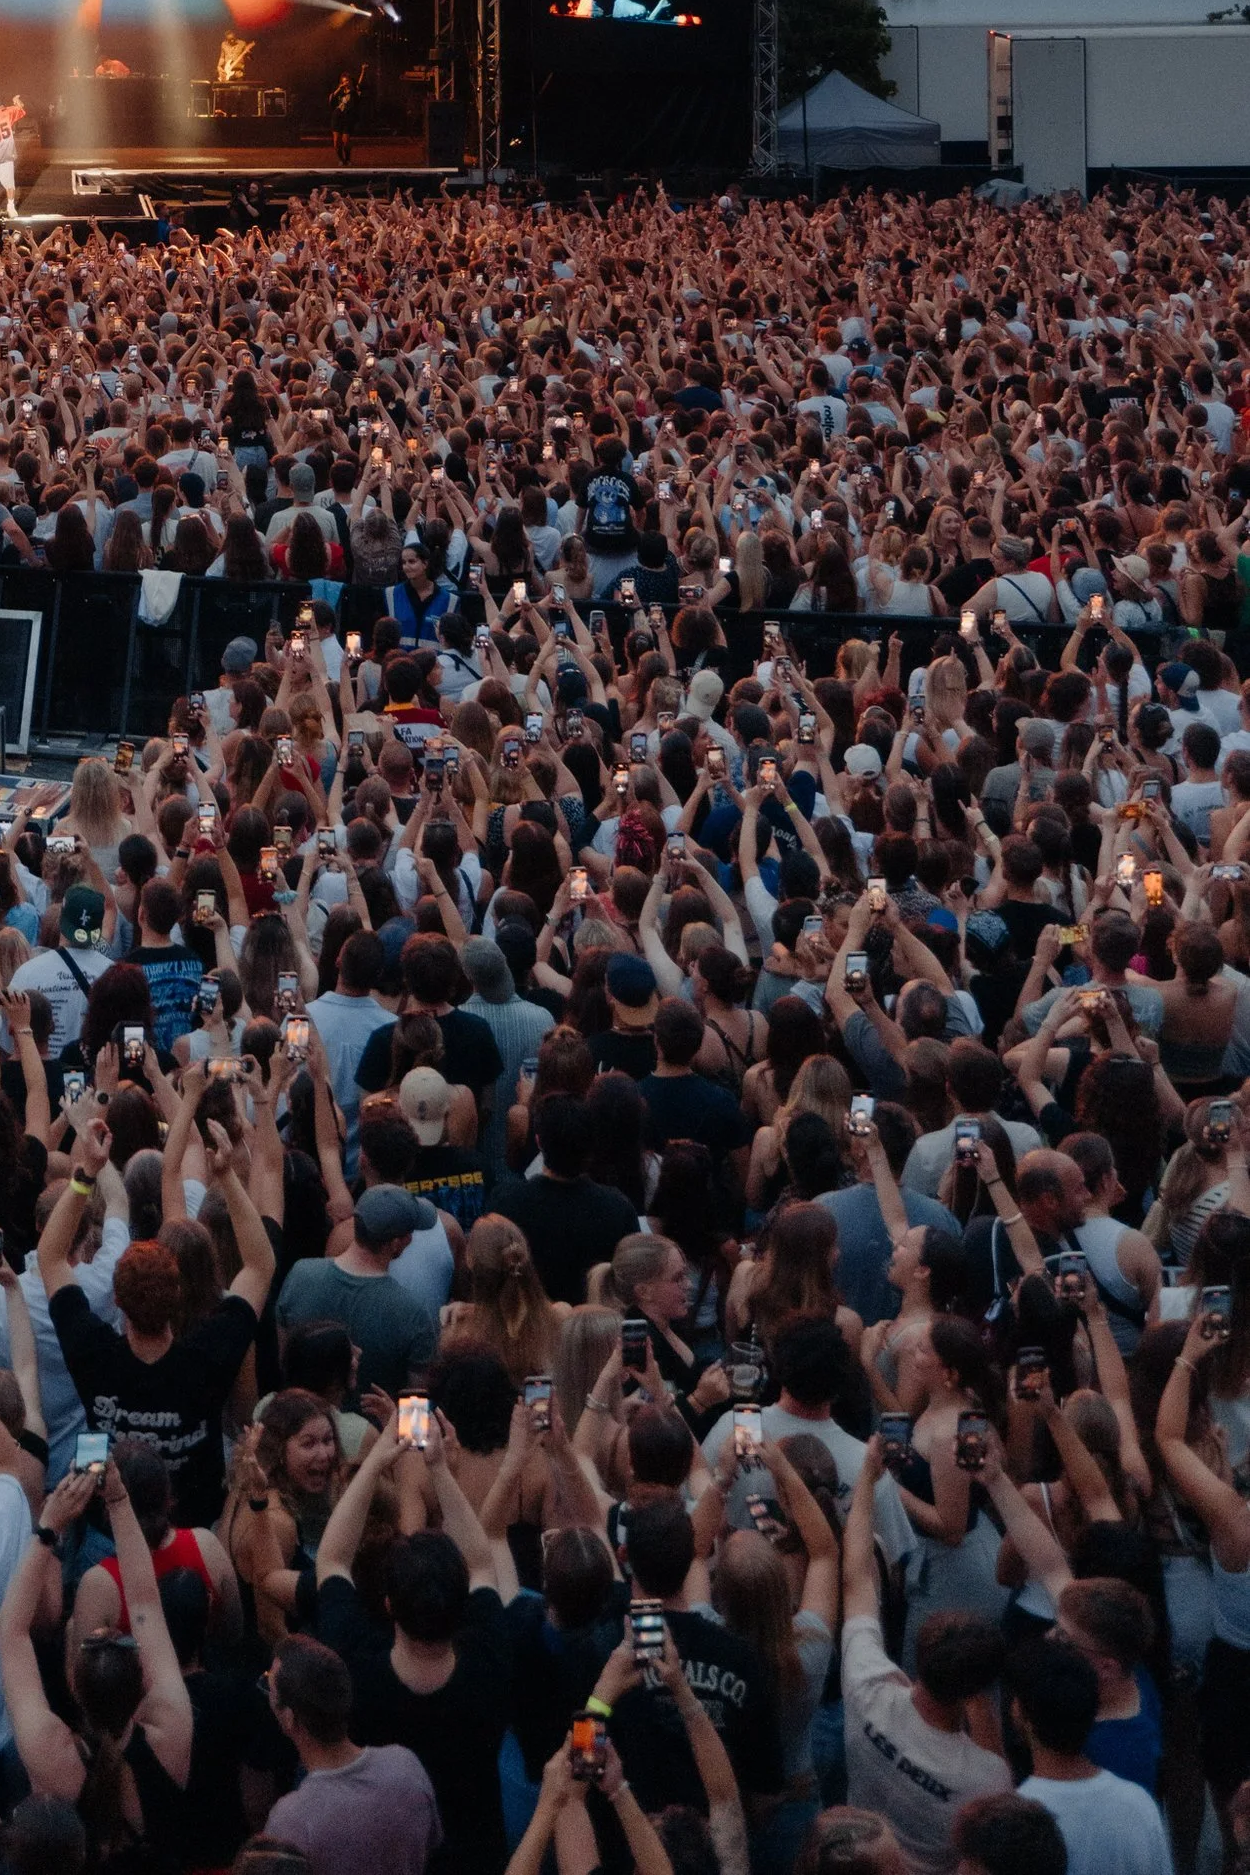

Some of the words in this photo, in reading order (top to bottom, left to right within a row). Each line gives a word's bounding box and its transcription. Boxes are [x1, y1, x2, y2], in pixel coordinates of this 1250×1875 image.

[92, 1394, 182, 1428] Dream
[863, 1721, 898, 1761] LES
[896, 1756, 952, 1803] DEUX
